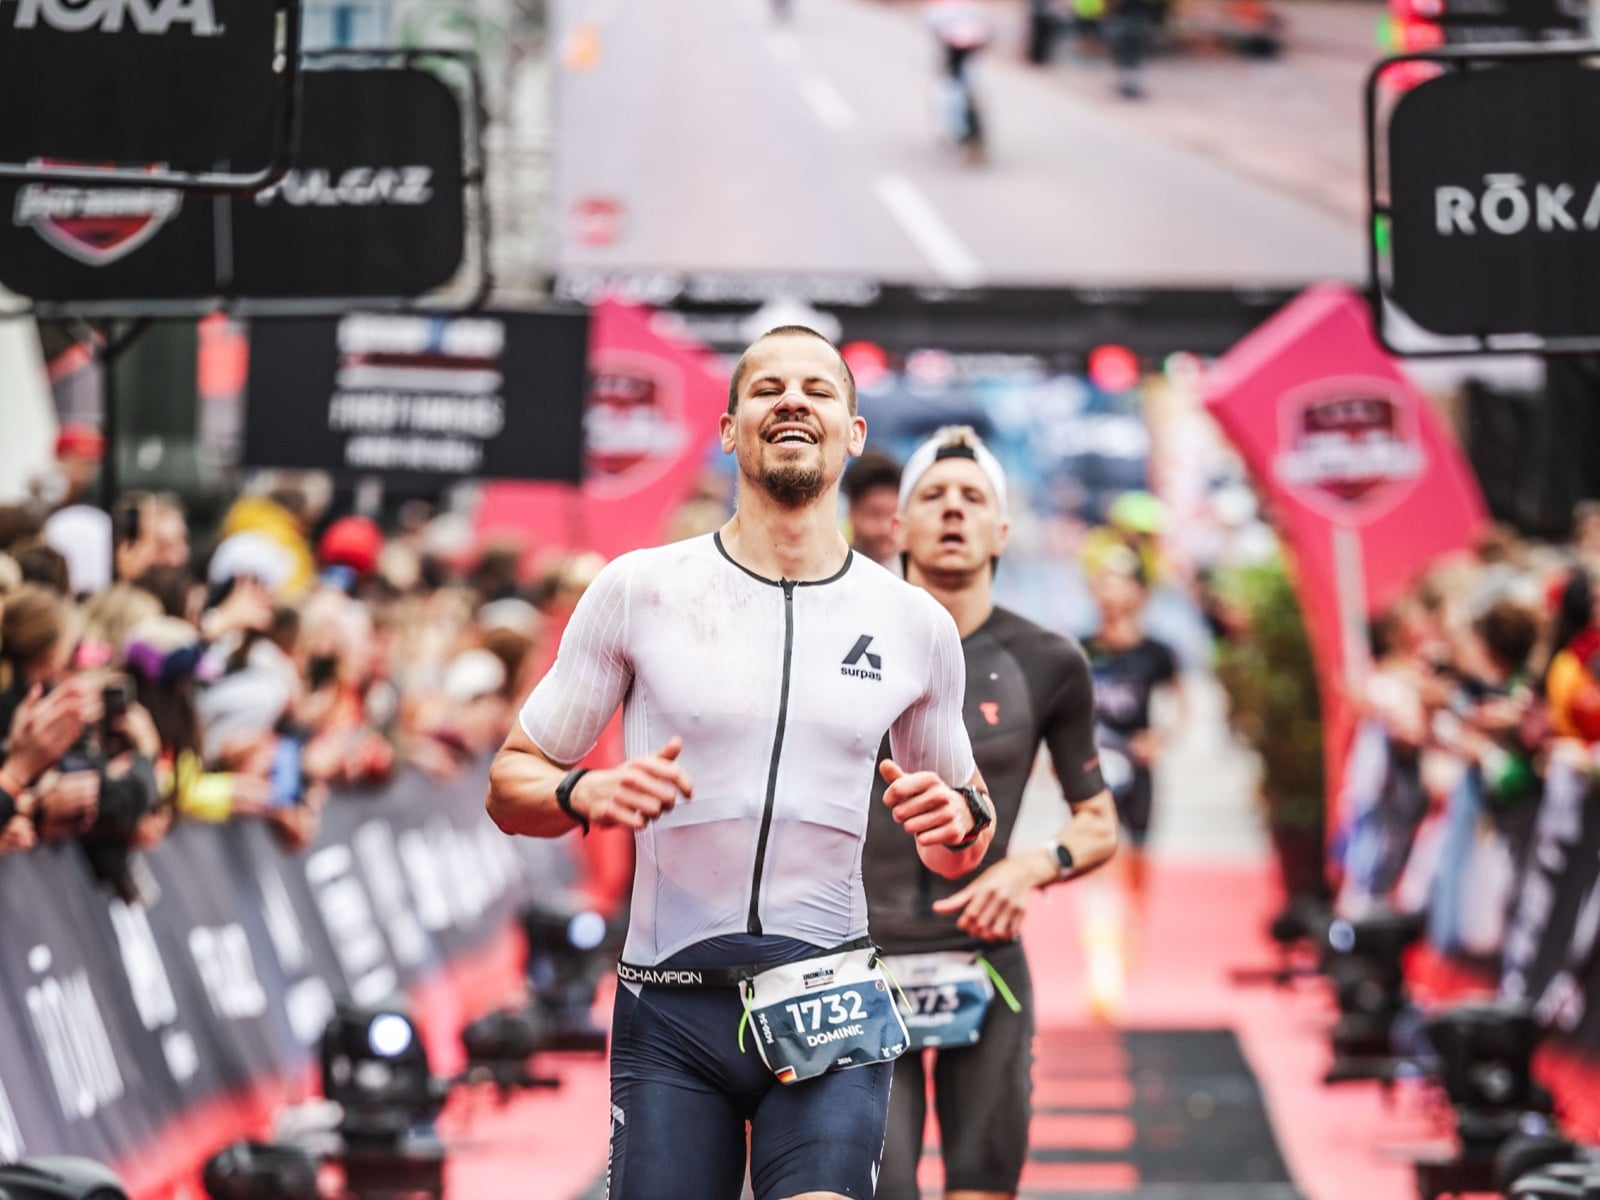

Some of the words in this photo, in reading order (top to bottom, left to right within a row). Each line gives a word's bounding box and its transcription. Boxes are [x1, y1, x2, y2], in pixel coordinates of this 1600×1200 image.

[13, 0, 218, 37] OKA
[841, 667, 882, 682] surpas
[786, 991, 868, 1034] 1732
[806, 1024, 865, 1047] DOMINIC
